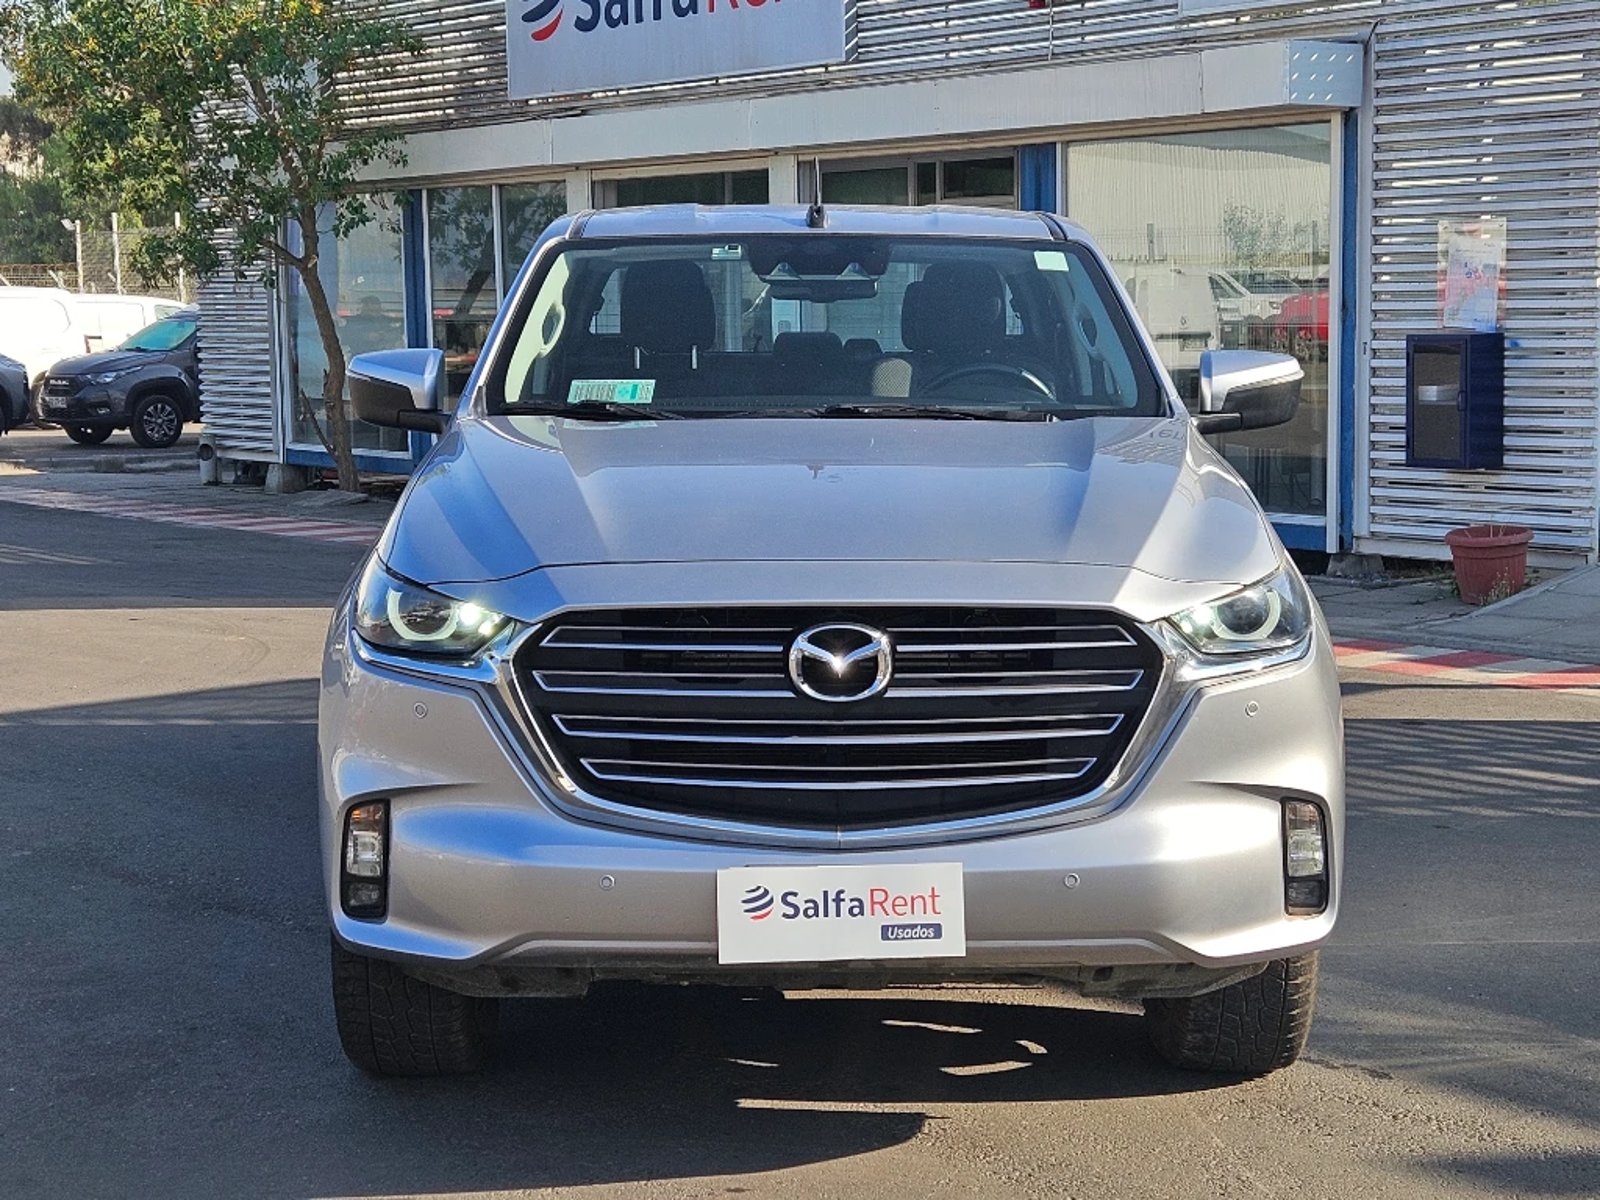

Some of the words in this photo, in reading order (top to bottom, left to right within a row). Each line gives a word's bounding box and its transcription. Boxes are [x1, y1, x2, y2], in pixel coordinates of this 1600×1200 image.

[574, 0, 781, 32] Salfa
[780, 886, 942, 919] SalfaRent
[887, 925, 935, 940] Usados
